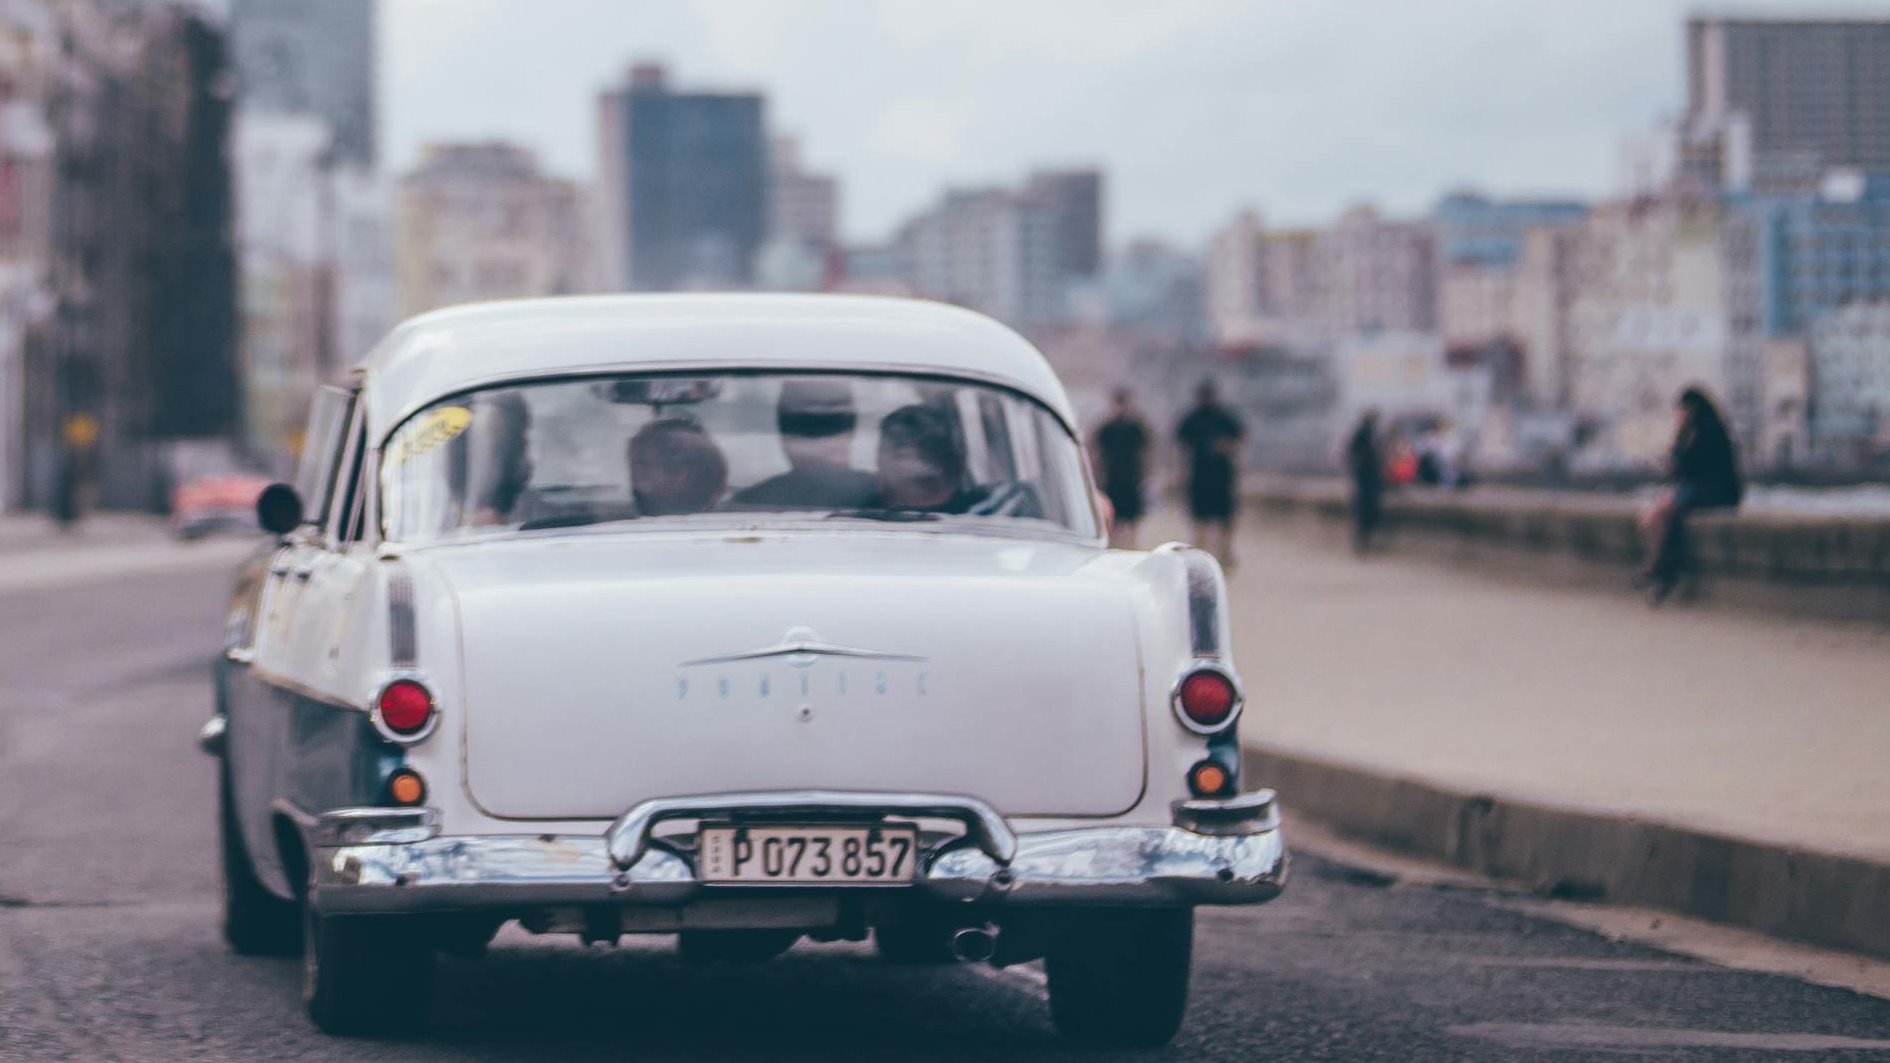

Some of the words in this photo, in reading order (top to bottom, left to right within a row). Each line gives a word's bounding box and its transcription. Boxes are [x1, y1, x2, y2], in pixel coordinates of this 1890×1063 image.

[733, 837, 752, 876] P
[764, 837, 831, 876] 073
[842, 837, 910, 876] 857
